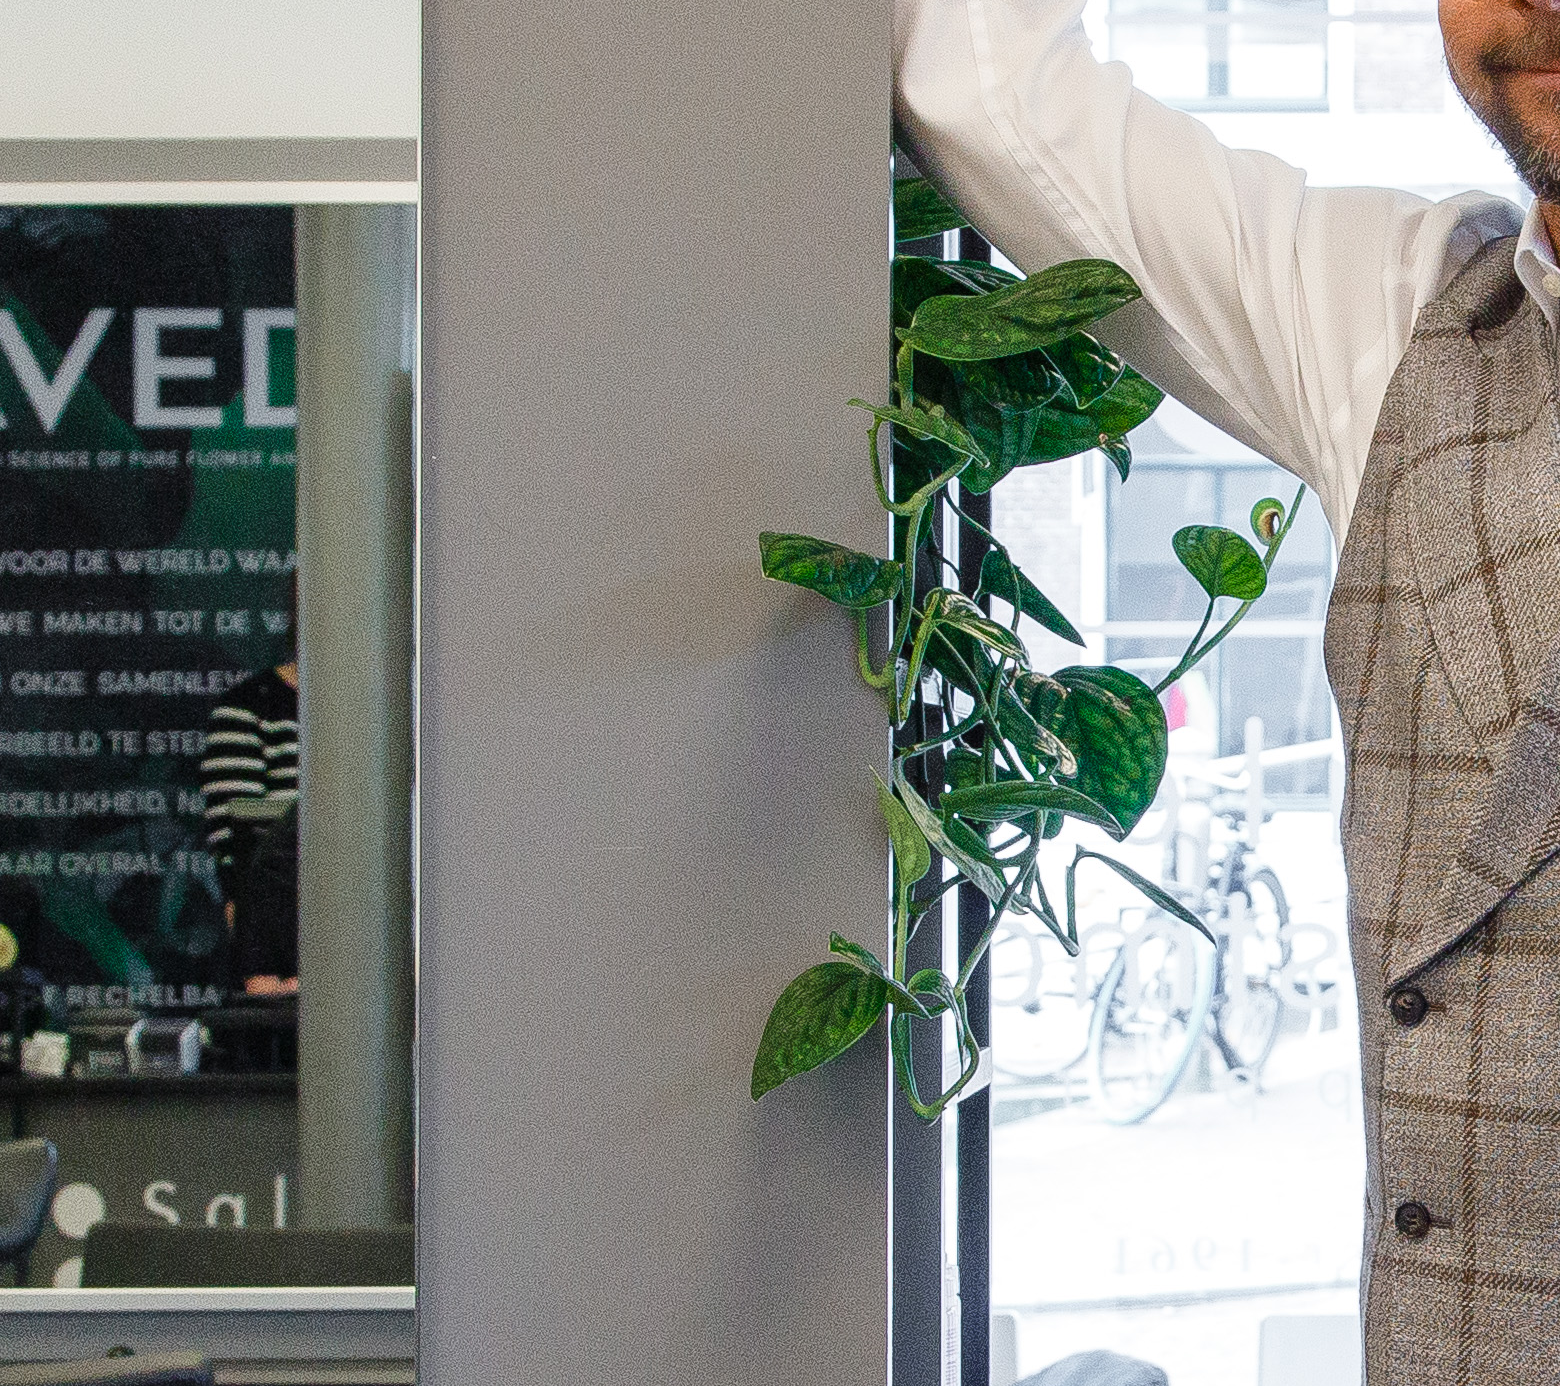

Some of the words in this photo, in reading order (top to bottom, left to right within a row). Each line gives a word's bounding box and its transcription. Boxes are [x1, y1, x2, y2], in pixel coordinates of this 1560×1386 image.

[74, 549, 111, 575] DE
[116, 549, 231, 575] WERELD
[42, 610, 144, 635] MAKEN
[152, 610, 206, 635] TOT
[214, 610, 251, 635] DE
[10, 669, 87, 695] ONZE
[108, 730, 142, 754] TE
[58, 852, 165, 875] OVERAL
